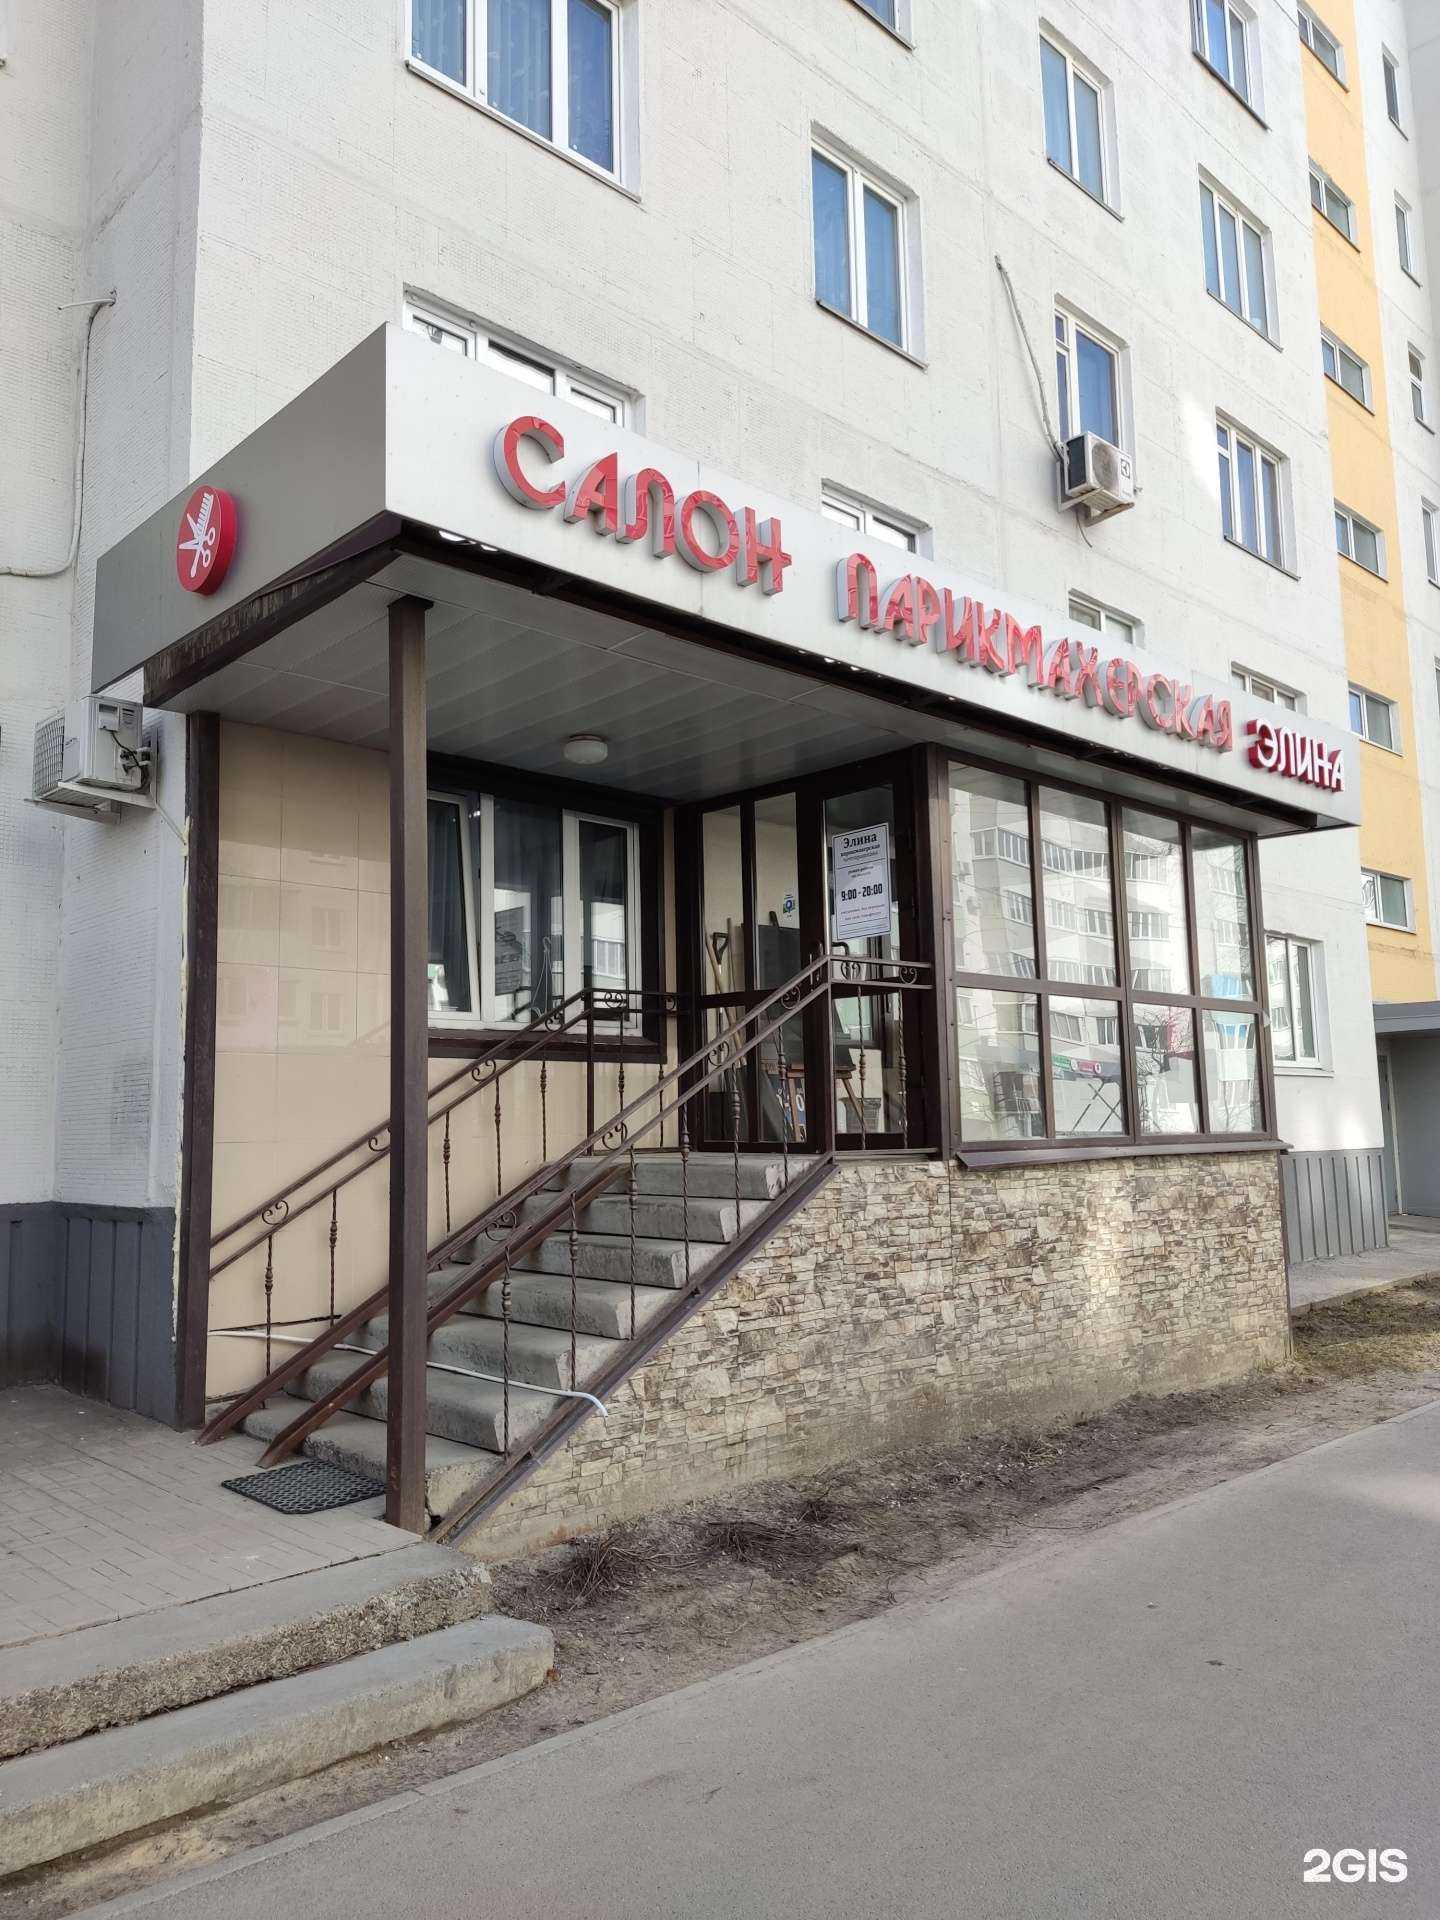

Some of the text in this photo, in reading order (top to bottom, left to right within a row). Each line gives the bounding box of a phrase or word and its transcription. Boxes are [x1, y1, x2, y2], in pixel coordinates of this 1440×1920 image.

[493, 415, 1345, 793] САЛОН ПАРИКМАХЕРСКАЯ ЭЛИНА
[843, 833, 877, 849] Элина
[841, 888, 857, 901] 9:00
[862, 883, 883, 898] 20:00
